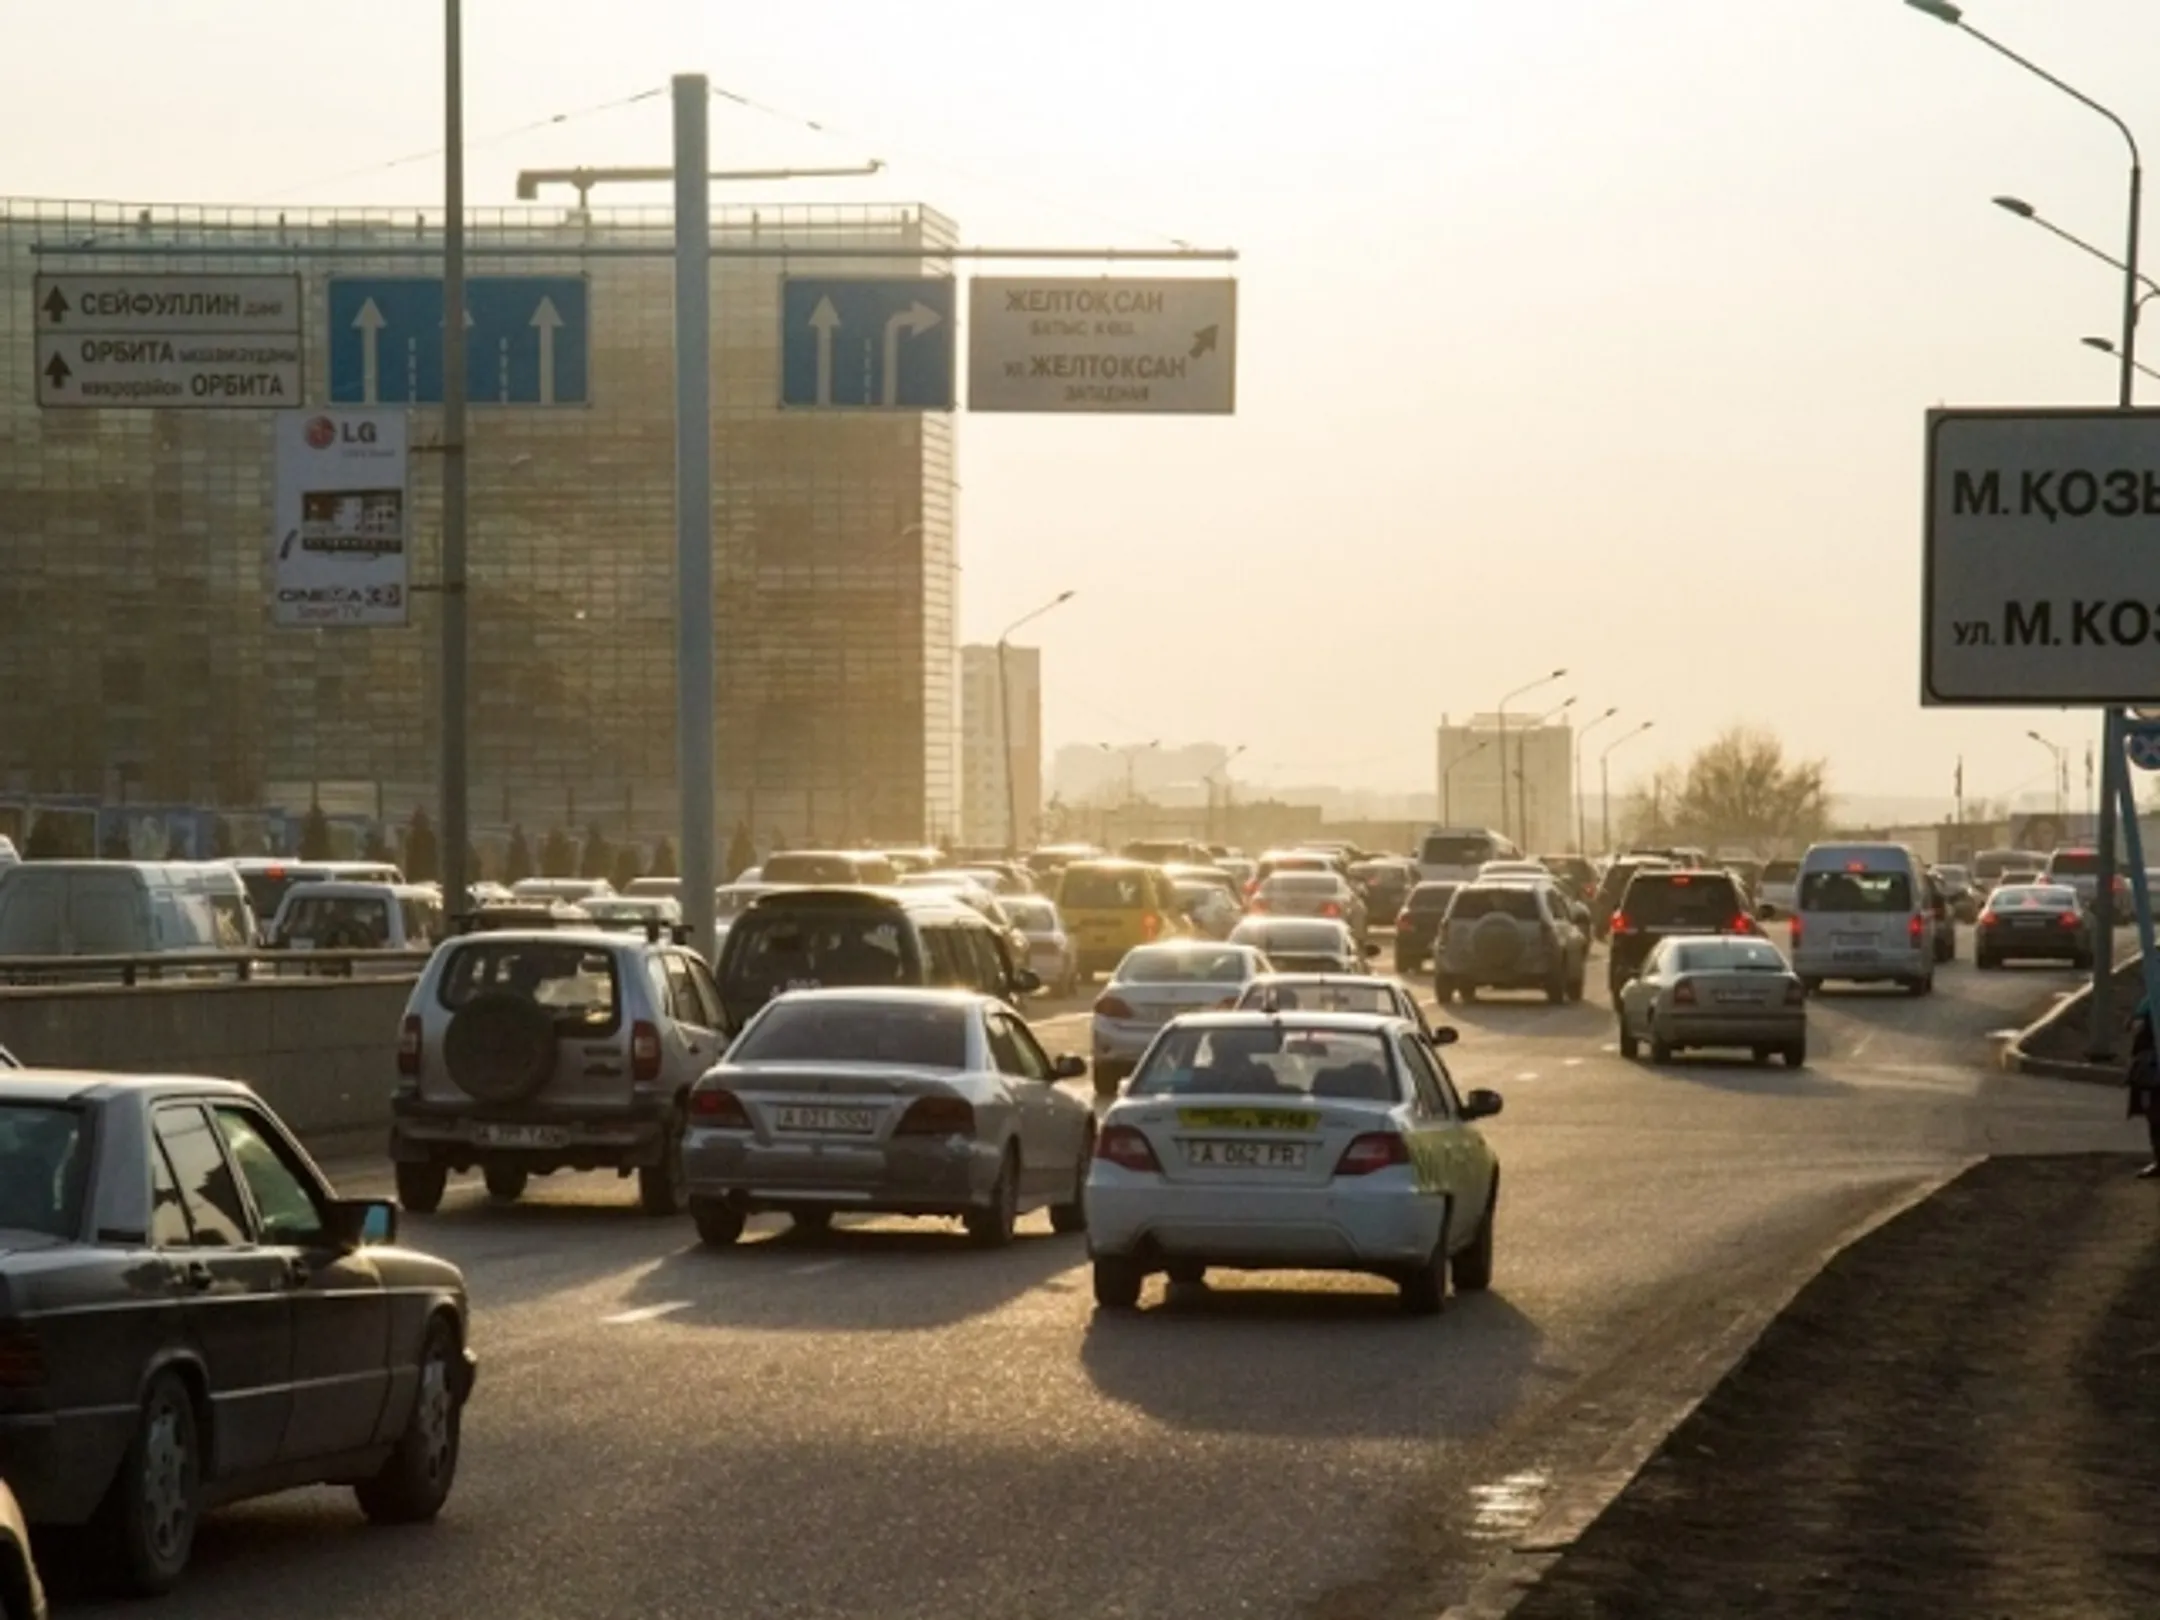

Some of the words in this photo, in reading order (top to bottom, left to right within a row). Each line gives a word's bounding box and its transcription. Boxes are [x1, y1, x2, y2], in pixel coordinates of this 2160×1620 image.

[80, 288, 240, 315] СЕЙФУЛЛИН
[1005, 289, 1164, 315] ЖЕЛТОҚСАН
[80, 340, 174, 363] ОРБИТА
[1030, 354, 1186, 379] ЖЕЛТОКСАН
[81, 377, 183, 399] микрорайон
[191, 373, 284, 397] ОРБИТА
[341, 421, 377, 443] LG
[2072, 600, 2160, 647] КО
